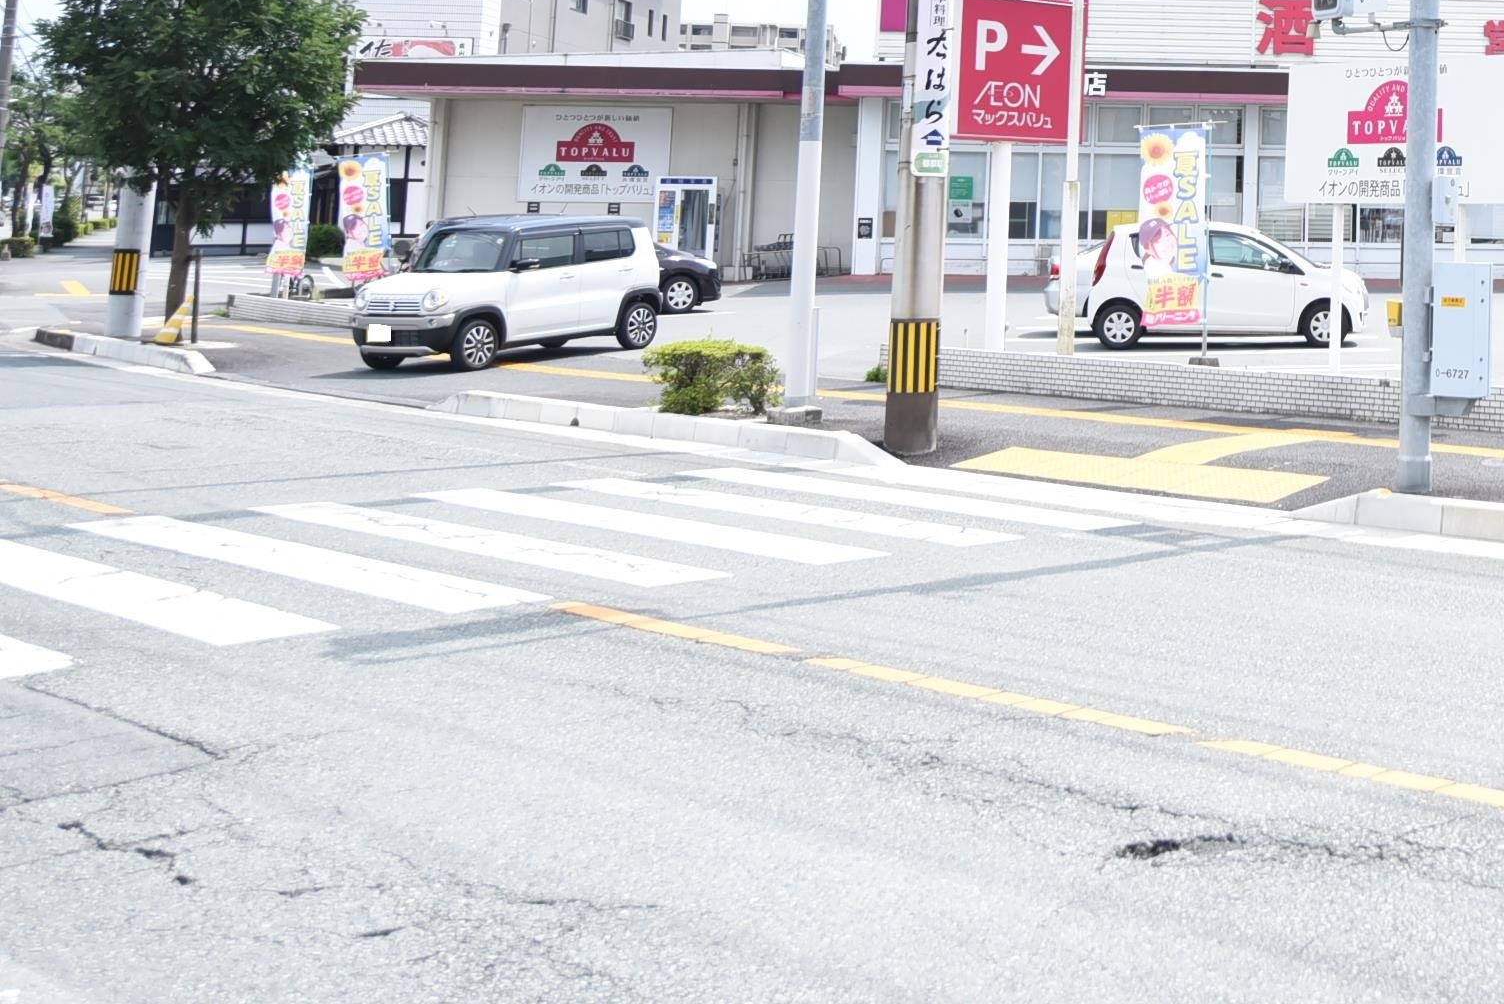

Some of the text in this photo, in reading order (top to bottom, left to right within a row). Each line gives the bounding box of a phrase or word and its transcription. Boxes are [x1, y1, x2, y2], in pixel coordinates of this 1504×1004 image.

[975, 19, 1008, 71] P
[1083, 71, 1107, 96] 店
[1367, 84, 1390, 112] QUALITY
[972, 109, 1053, 129] マックスバリュ
[1352, 119, 1408, 136] TOPVA
[560, 147, 630, 157] TOPVALU
[1174, 151, 1199, 273] 夏SALE
[1154, 282, 1197, 308] 半額
